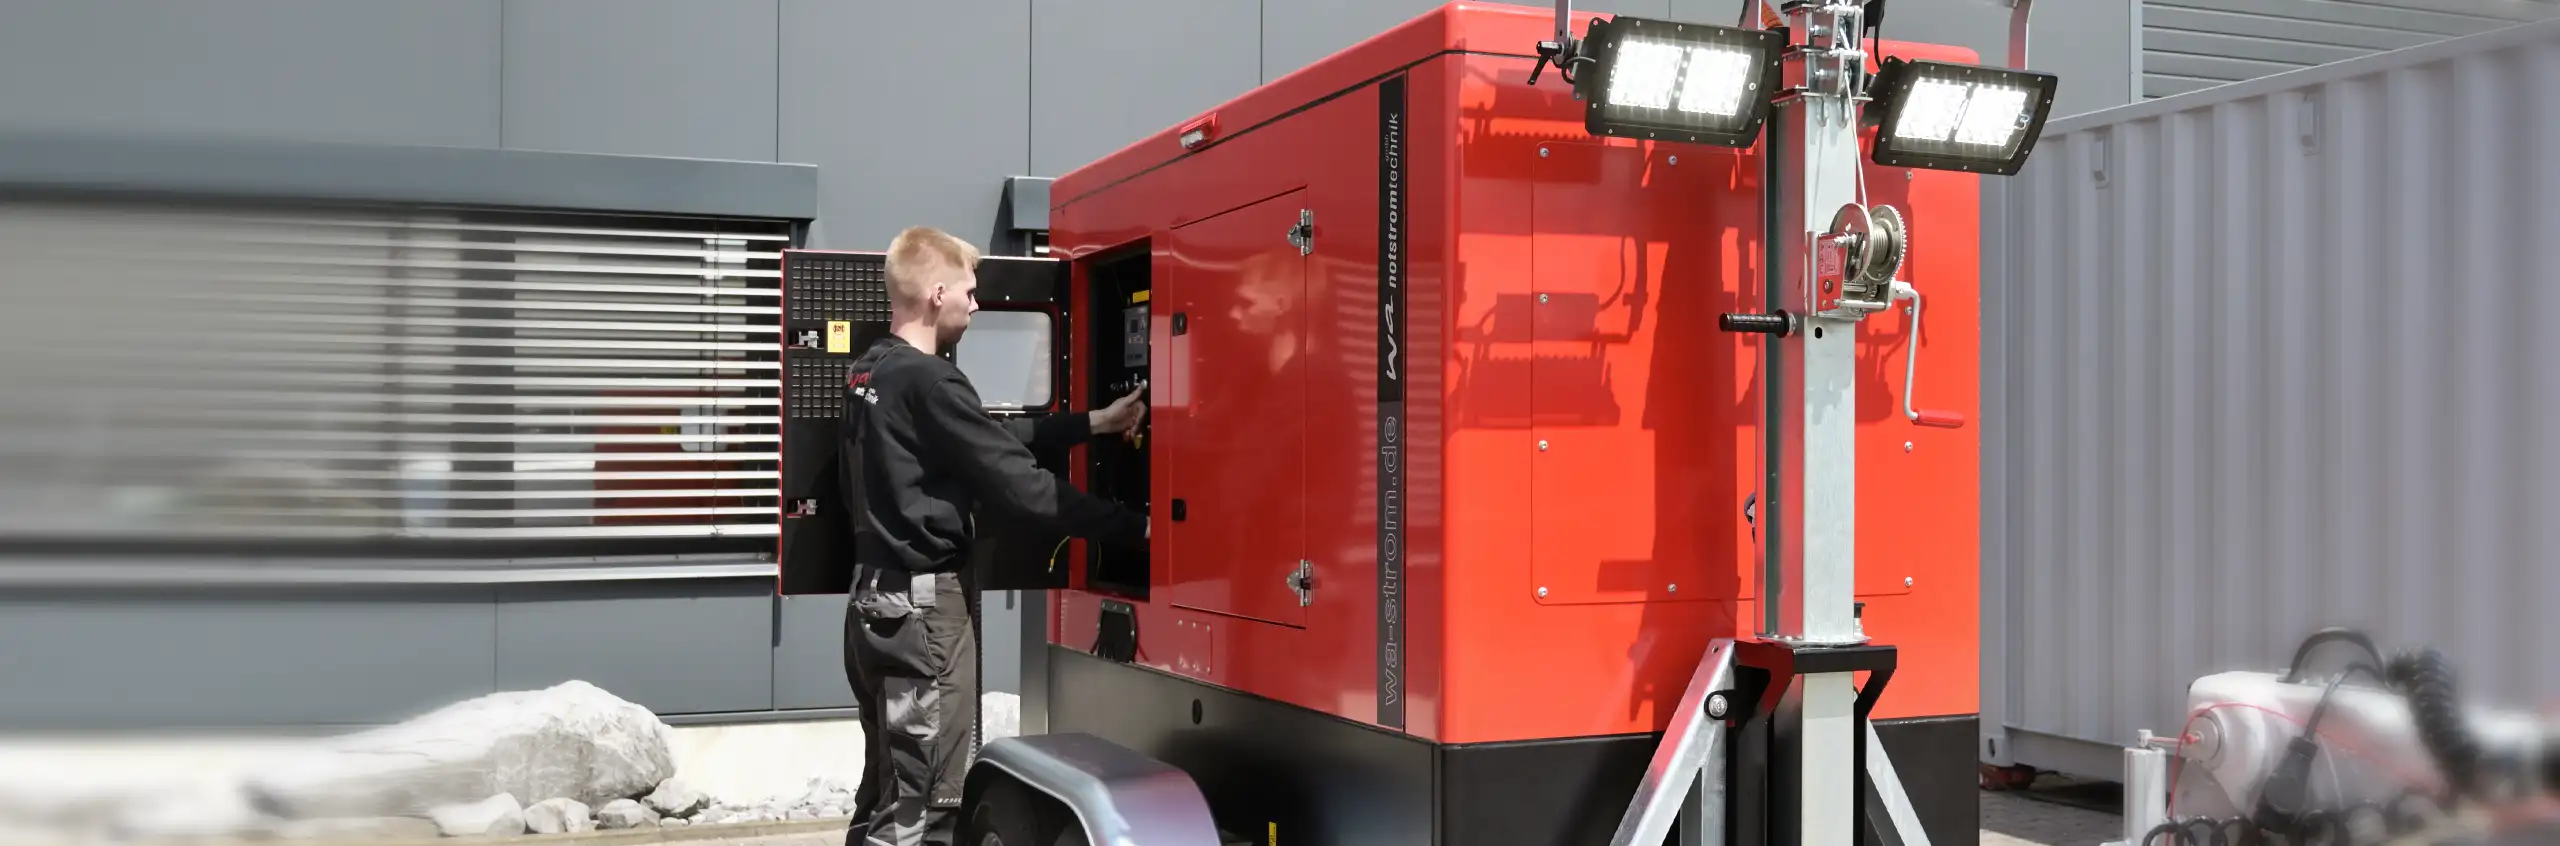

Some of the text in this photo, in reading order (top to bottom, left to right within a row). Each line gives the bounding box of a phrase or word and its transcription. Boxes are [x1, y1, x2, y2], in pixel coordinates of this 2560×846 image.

[1384, 112, 1399, 381] wa notstromtechnik
[1381, 416, 1398, 706] wa-strom.de
